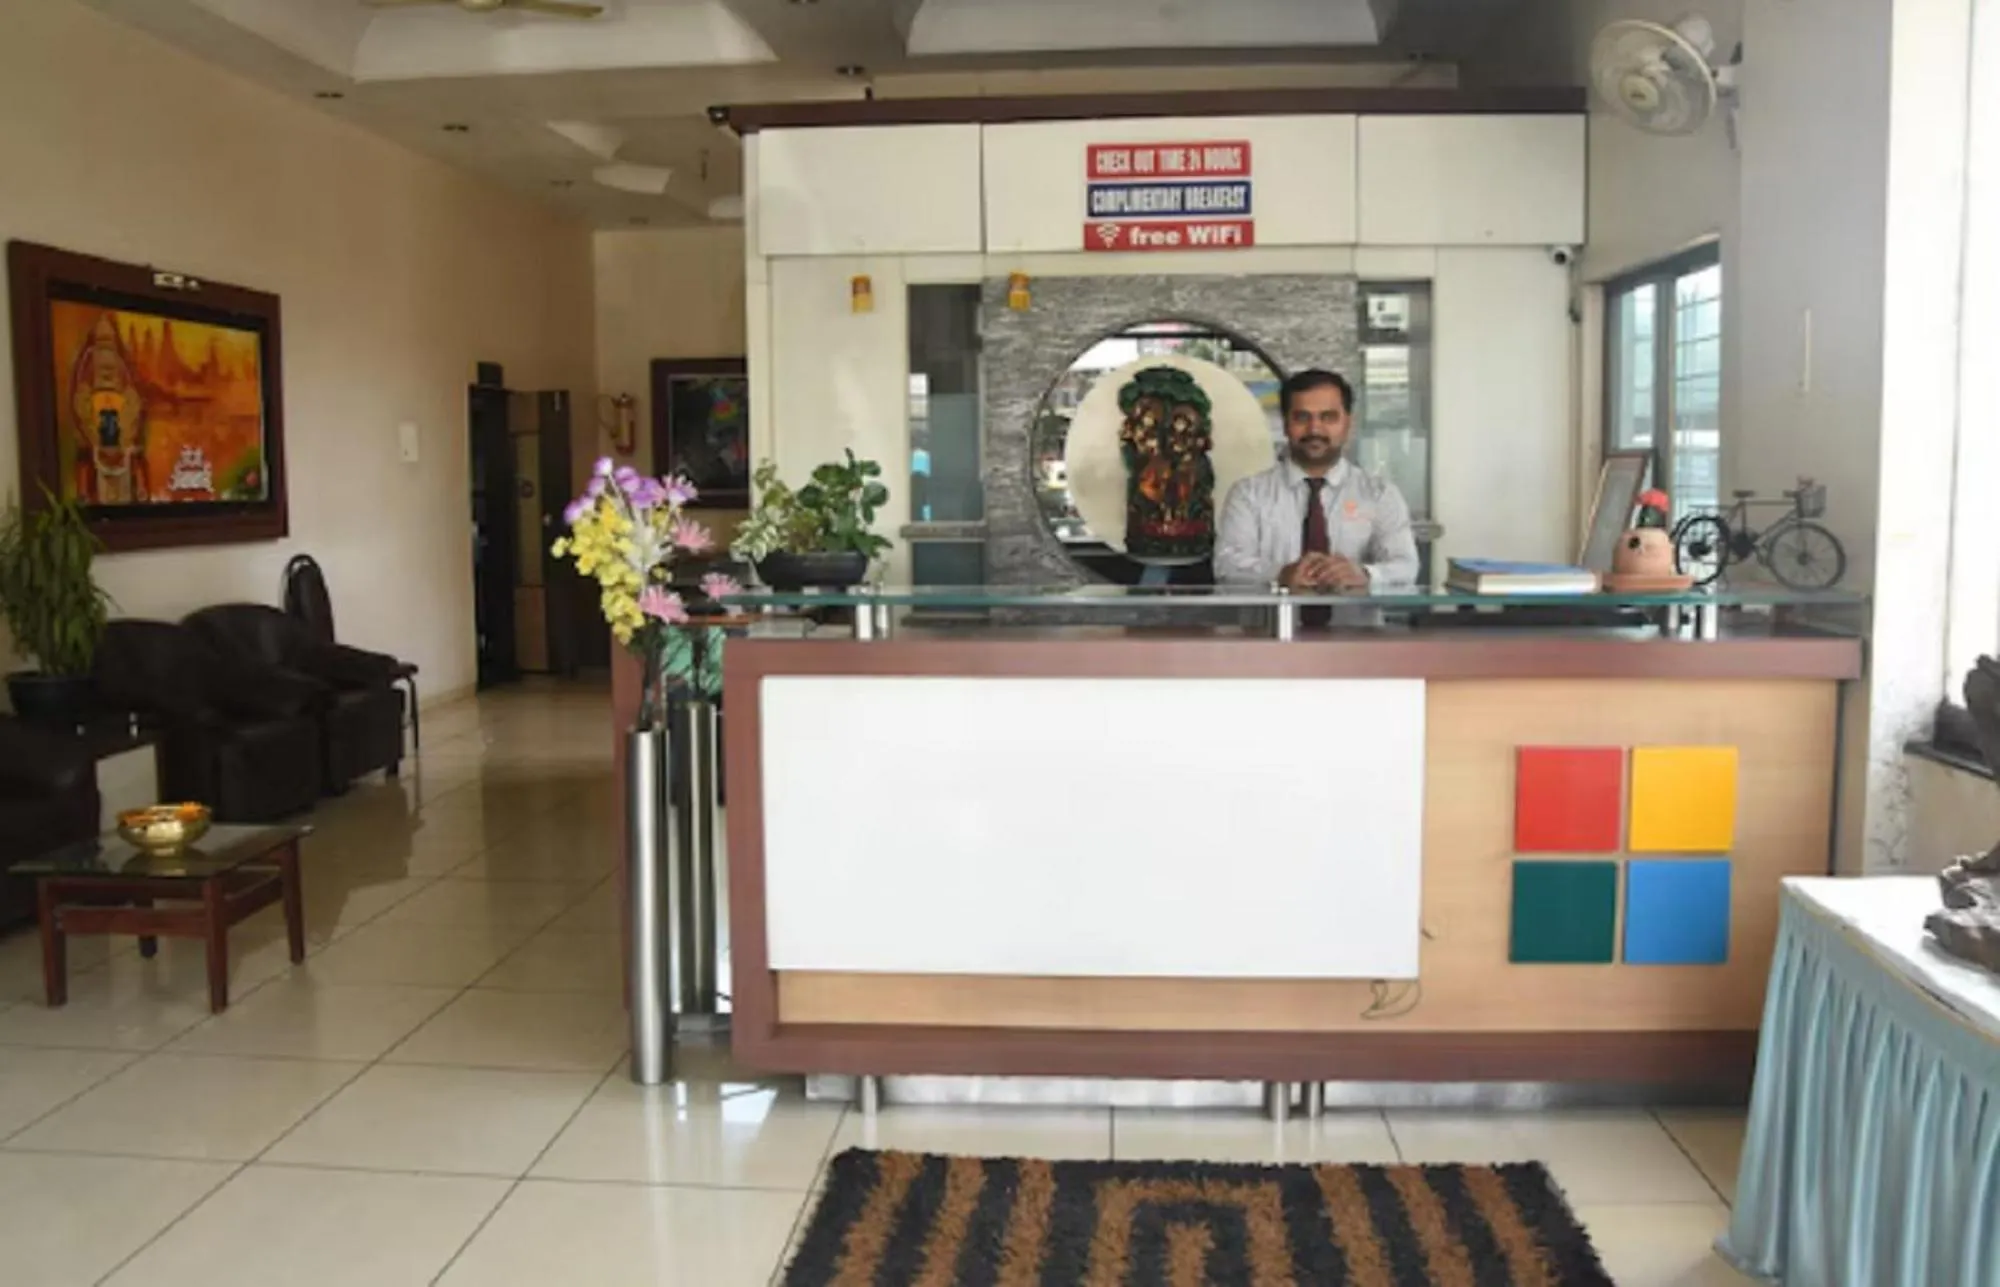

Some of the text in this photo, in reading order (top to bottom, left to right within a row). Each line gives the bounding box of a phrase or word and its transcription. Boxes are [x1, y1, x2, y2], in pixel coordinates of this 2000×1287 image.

[1096, 149, 1130, 173] CHECK
[1134, 149, 1154, 173] OUT
[1159, 148, 1186, 171] TIME
[1204, 147, 1241, 171] HOURS
[1185, 184, 1246, 210] BREAKFAST
[1129, 224, 1242, 246] free WiFi
